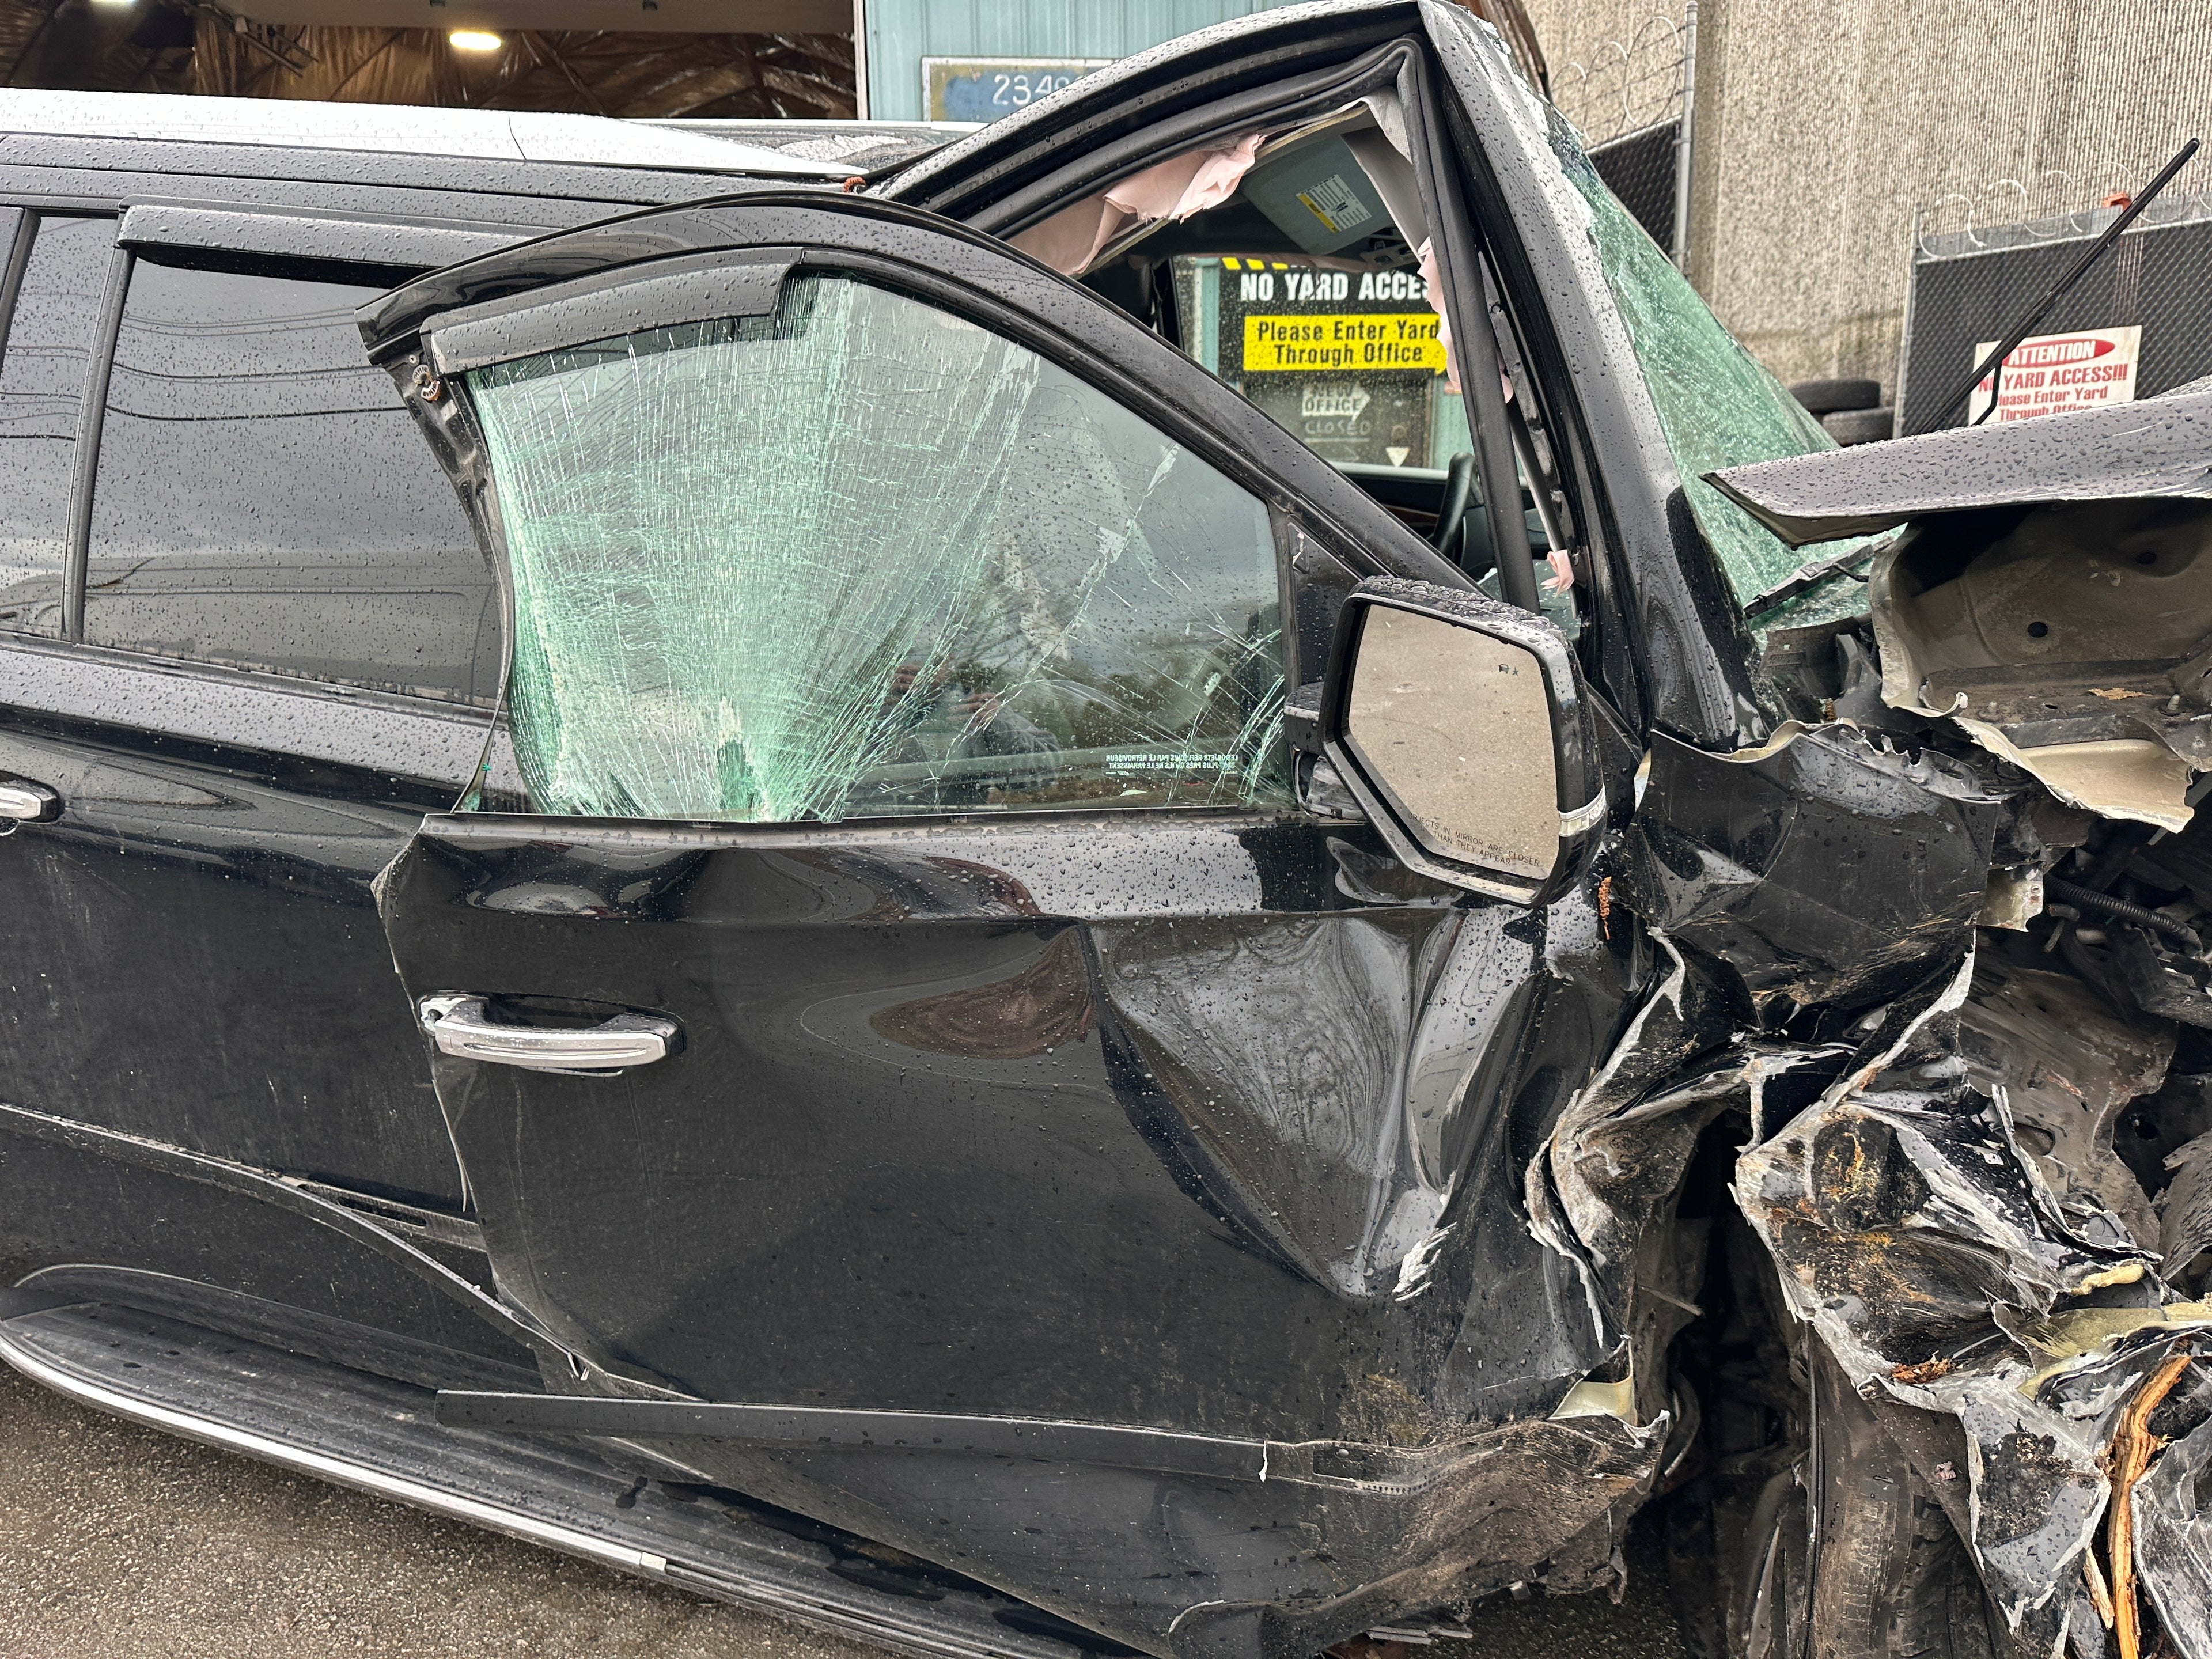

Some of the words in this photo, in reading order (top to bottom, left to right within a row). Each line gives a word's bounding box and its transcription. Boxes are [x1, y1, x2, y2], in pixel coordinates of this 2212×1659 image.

[992, 74, 1086, 105] 234
[1240, 272, 1274, 301] NO
[1283, 272, 1349, 301] YARD
[1258, 320, 1323, 341] Please
[1334, 320, 1387, 340] Enter
[1397, 319, 1439, 340] Yard
[1274, 343, 1354, 367] Through
[1363, 342, 1423, 363] Office
[2008, 340, 2096, 366] ATTENTION
[1313, 382, 1354, 397] NEW
[2003, 371, 2046, 391] YARD
[2049, 363, 2128, 387] ACCESS!!!
[1305, 397, 1362, 412] OFFICE
[1998, 393, 2031, 406] lease
[2034, 390, 2070, 403] Enter
[2075, 385, 2108, 400] Yard
[1304, 419, 1372, 435] CLOSED
[1407, 812, 1440, 830] OBJECTS
[1443, 825, 1450, 835] IN
[1455, 830, 1483, 847] MIRROR
[1488, 843, 1503, 854] ARE
[1508, 850, 1540, 868] CLOSER
[1433, 830, 1452, 844] THAN
[1457, 840, 1476, 853] THEY
[1479, 849, 1511, 866] APPEAR
